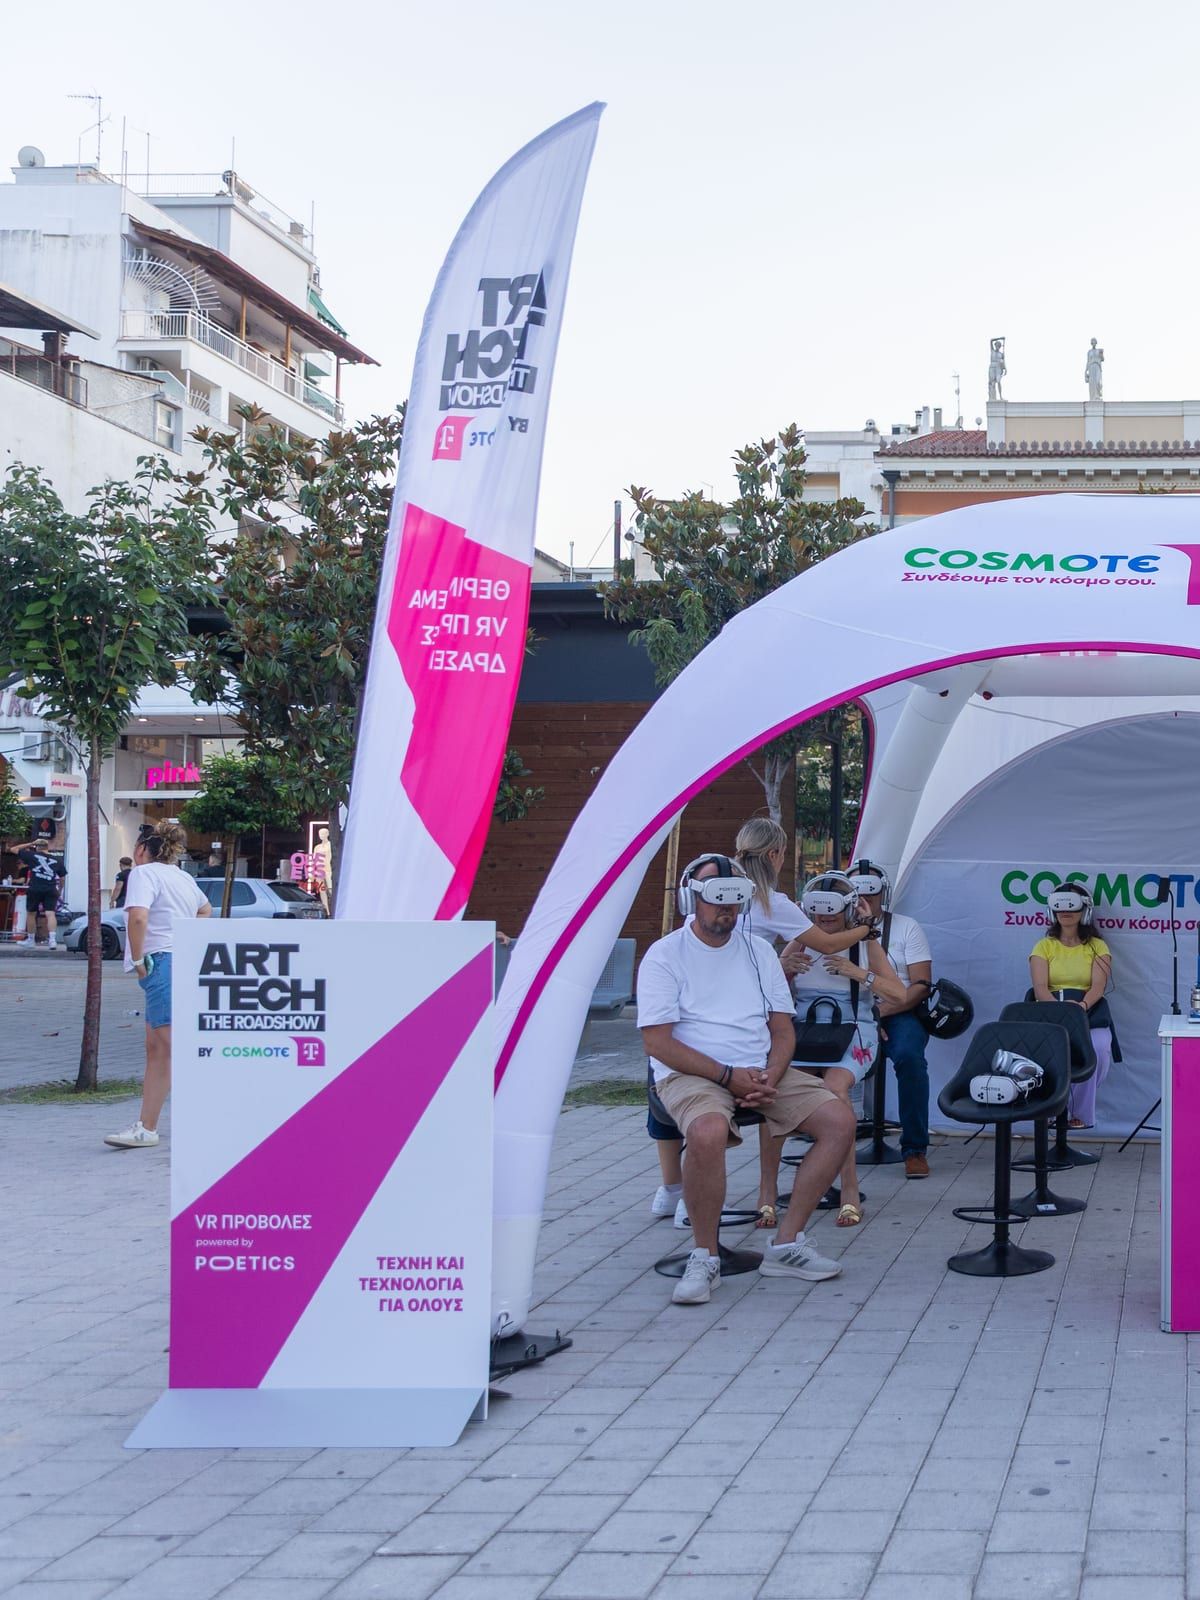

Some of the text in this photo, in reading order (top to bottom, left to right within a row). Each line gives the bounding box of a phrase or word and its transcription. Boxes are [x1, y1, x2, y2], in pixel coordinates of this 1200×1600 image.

[904, 547, 1161, 573] COSMOTE
[901, 571, 1156, 588] Συνδέουμε τον κόσμο σου.
[147, 760, 200, 788] pink
[1099, 918, 1124, 929] τον
[1127, 916, 1183, 933] κόσμο
[199, 943, 300, 976] ART
[199, 978, 326, 1011] TECH
[203, 1015, 320, 1030] THE ROADSHOW
[198, 1047, 213, 1057] BY
[222, 1047, 290, 1057] COSMOTE
[195, 1215, 312, 1229] VR ΠΡΟΒΟΛΕΣ
[196, 1238, 254, 1248] powered by
[195, 1256, 295, 1270] POETICS
[377, 1256, 464, 1270] ΤΕΧΝΗ ΚΑΙ
[359, 1277, 464, 1291] ΤΕΧΝΟΛΟΓΙΑ
[379, 1298, 463, 1312] ΓΙΑ ΟΛΟΥΣ
